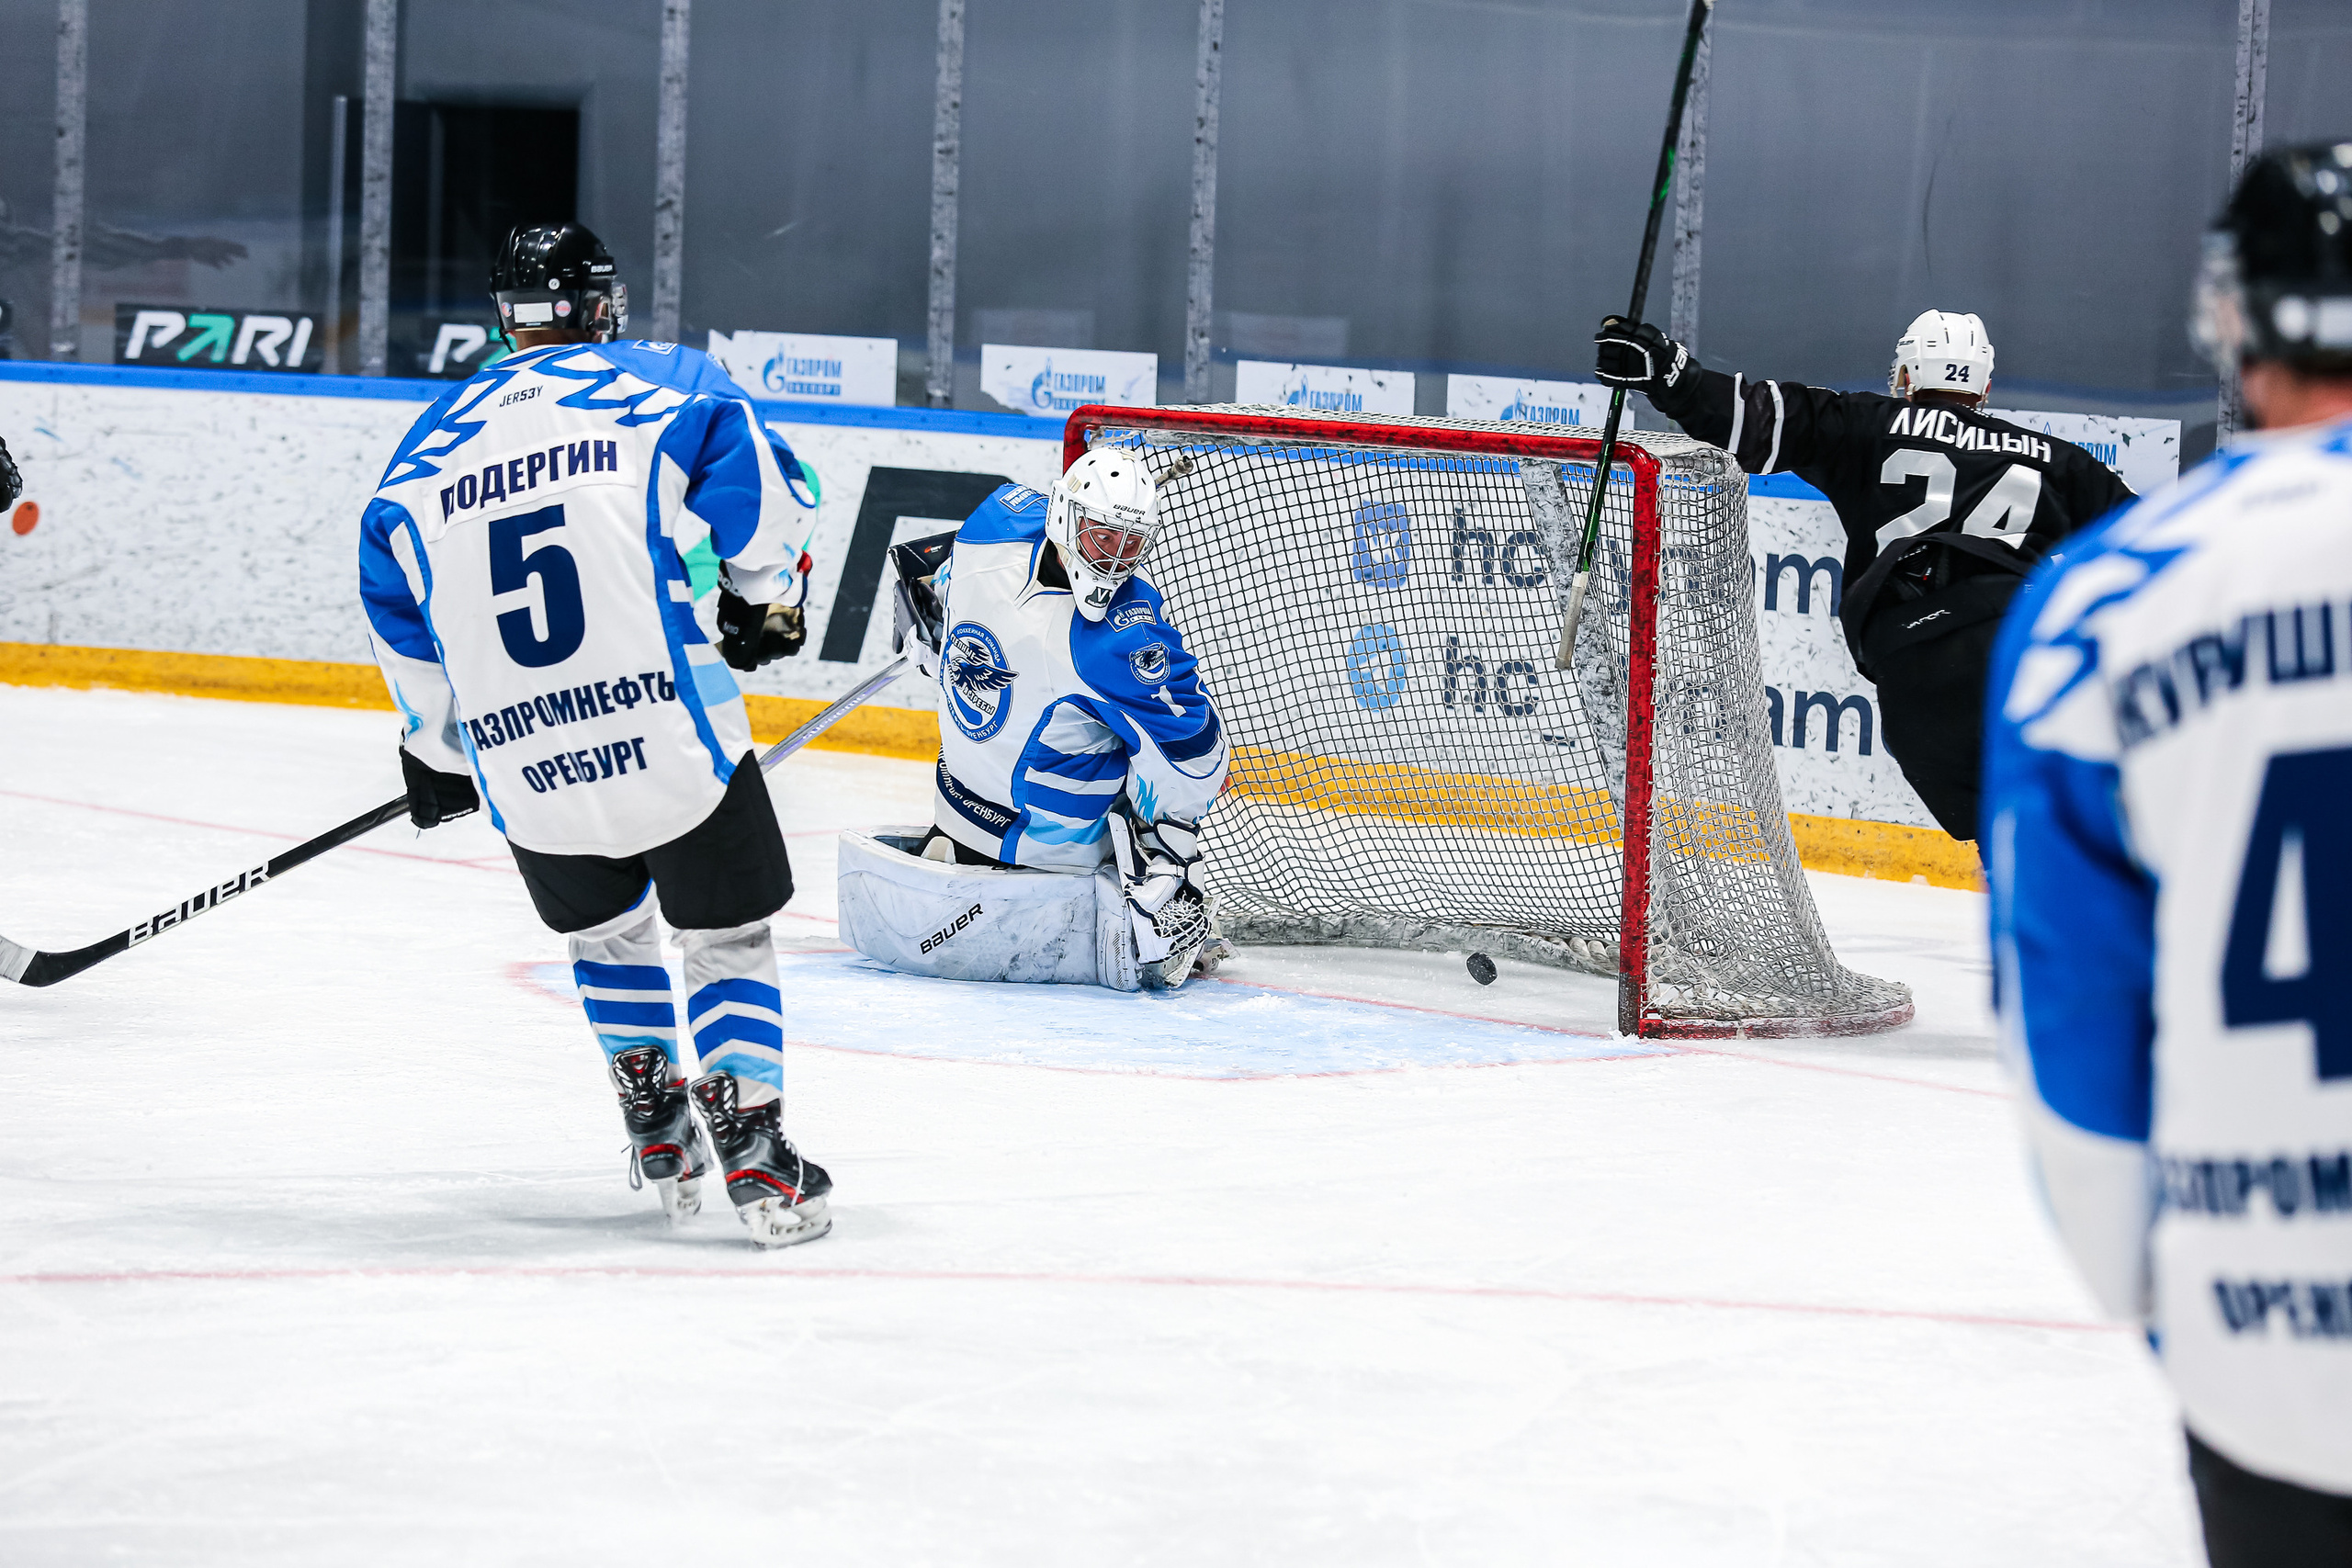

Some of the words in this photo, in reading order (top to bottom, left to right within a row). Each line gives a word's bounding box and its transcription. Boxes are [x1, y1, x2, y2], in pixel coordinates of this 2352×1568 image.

[123, 310, 314, 368] PARI
[1309, 390, 1363, 412] ГАЗПРОМ
[1944, 363, 1971, 383] 24
[1523, 403, 1580, 426] ГАЗПРОМ
[1889, 407, 2052, 462] ЛИСИЦЫН
[439, 439, 617, 525] ПОДЕРГИН
[1113, 502, 1147, 516] BAUER
[1875, 448, 2042, 557] 24
[489, 503, 585, 669] 5
[462, 671, 676, 751] АЗПРОМНЕФТЬ
[128, 859, 270, 947] BAUER
[920, 901, 984, 956] BAUER
